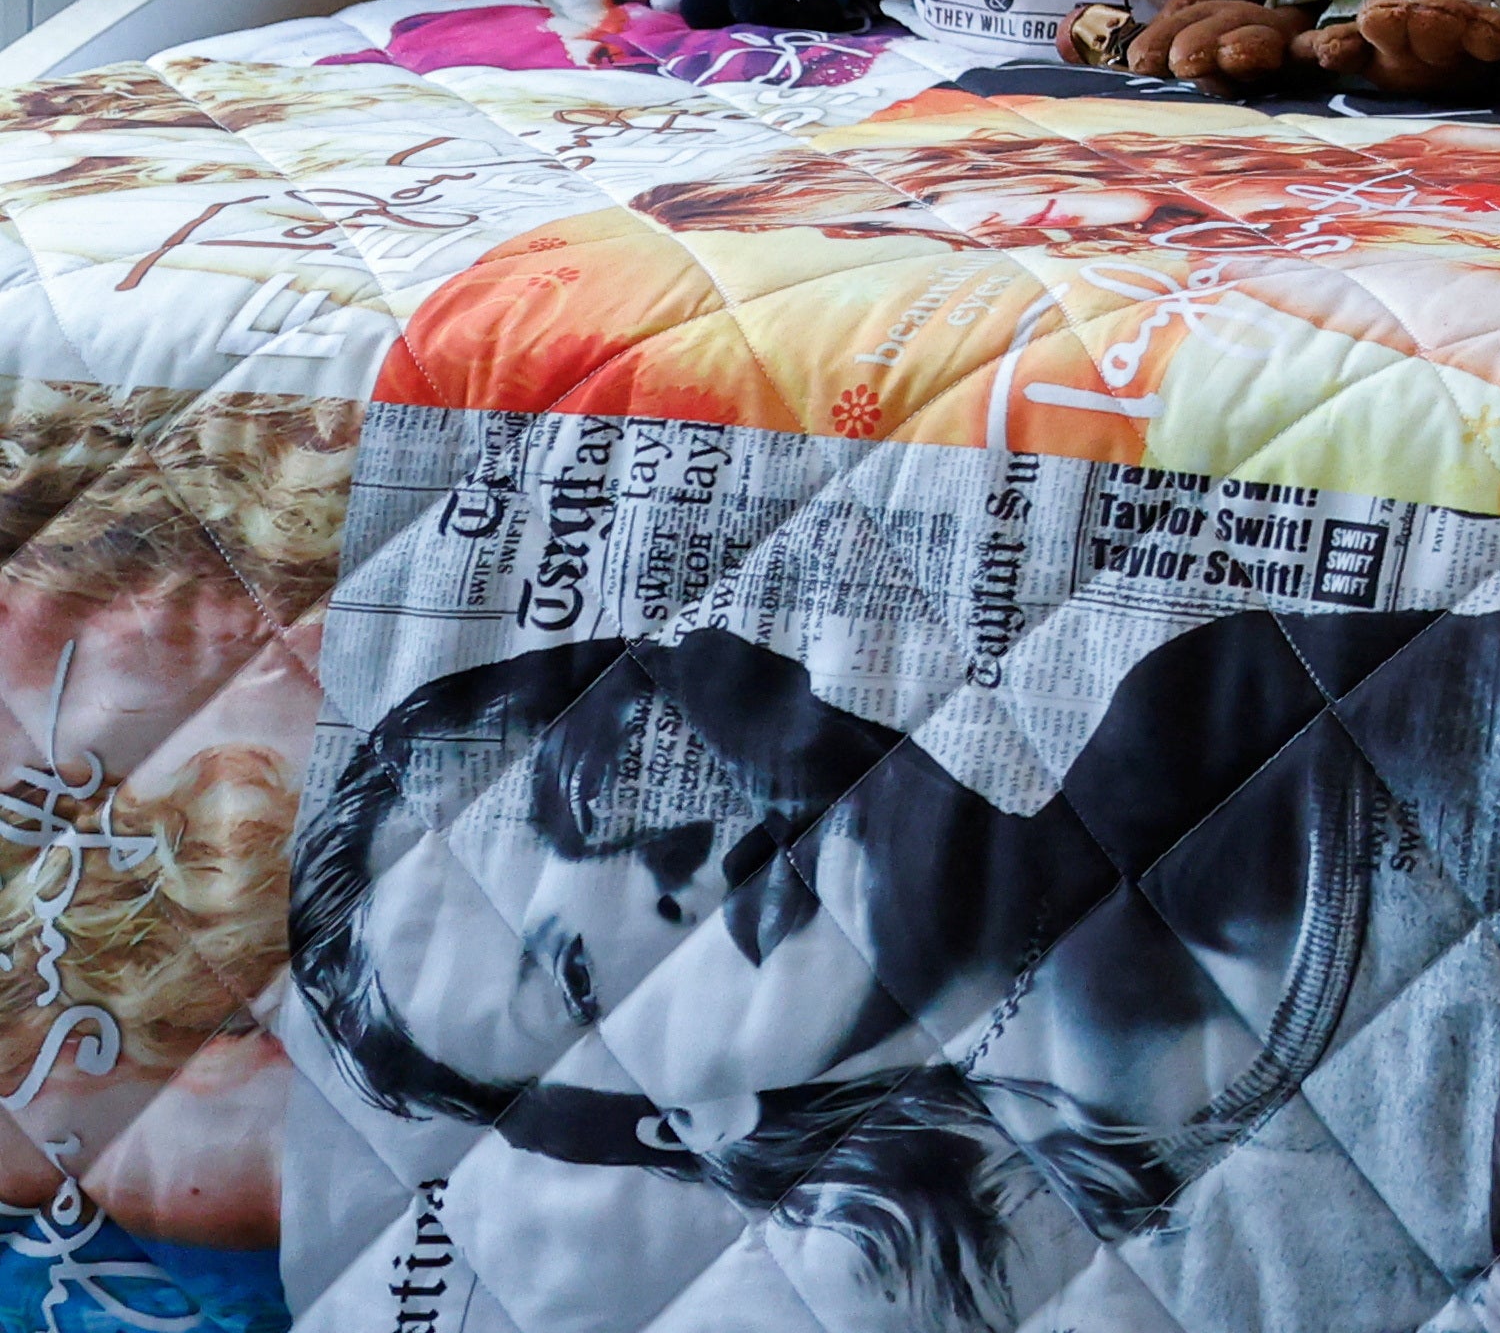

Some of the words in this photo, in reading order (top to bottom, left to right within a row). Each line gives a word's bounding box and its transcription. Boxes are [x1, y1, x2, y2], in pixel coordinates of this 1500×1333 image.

[935, 7, 973, 30] THEY
[980, 14, 1016, 36] WILL
[1022, 17, 1058, 40] GRO
[947, 269, 1014, 327] eyes
[1099, 493, 1206, 537] Taylor
[1216, 507, 1313, 553] Swift!
[1329, 527, 1379, 551] SWIFT
[1091, 536, 1197, 587] Taylor
[1203, 552, 1306, 599] Swift!
[1326, 550, 1375, 574] SWIFT
[1321, 572, 1371, 598] SWIFT
